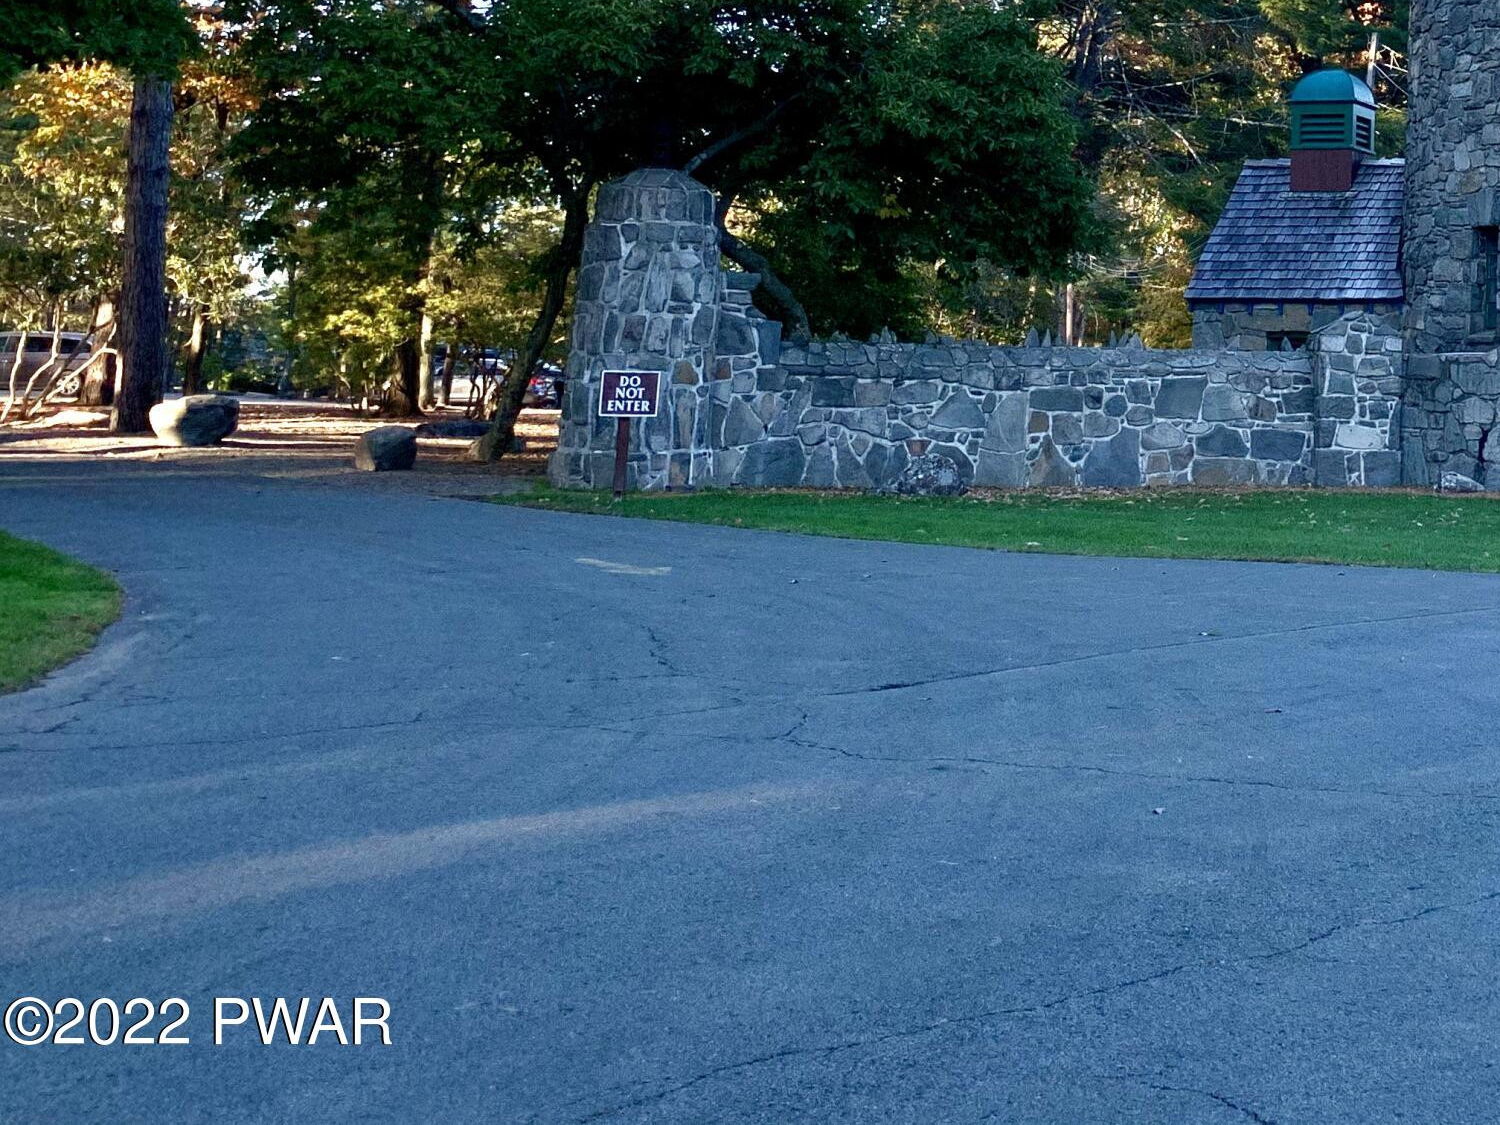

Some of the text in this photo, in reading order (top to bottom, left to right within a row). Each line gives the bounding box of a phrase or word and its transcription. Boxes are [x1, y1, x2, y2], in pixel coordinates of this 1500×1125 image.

[620, 375, 641, 387] DO
[615, 387, 646, 399] NOT
[607, 400, 650, 412] ENTER
